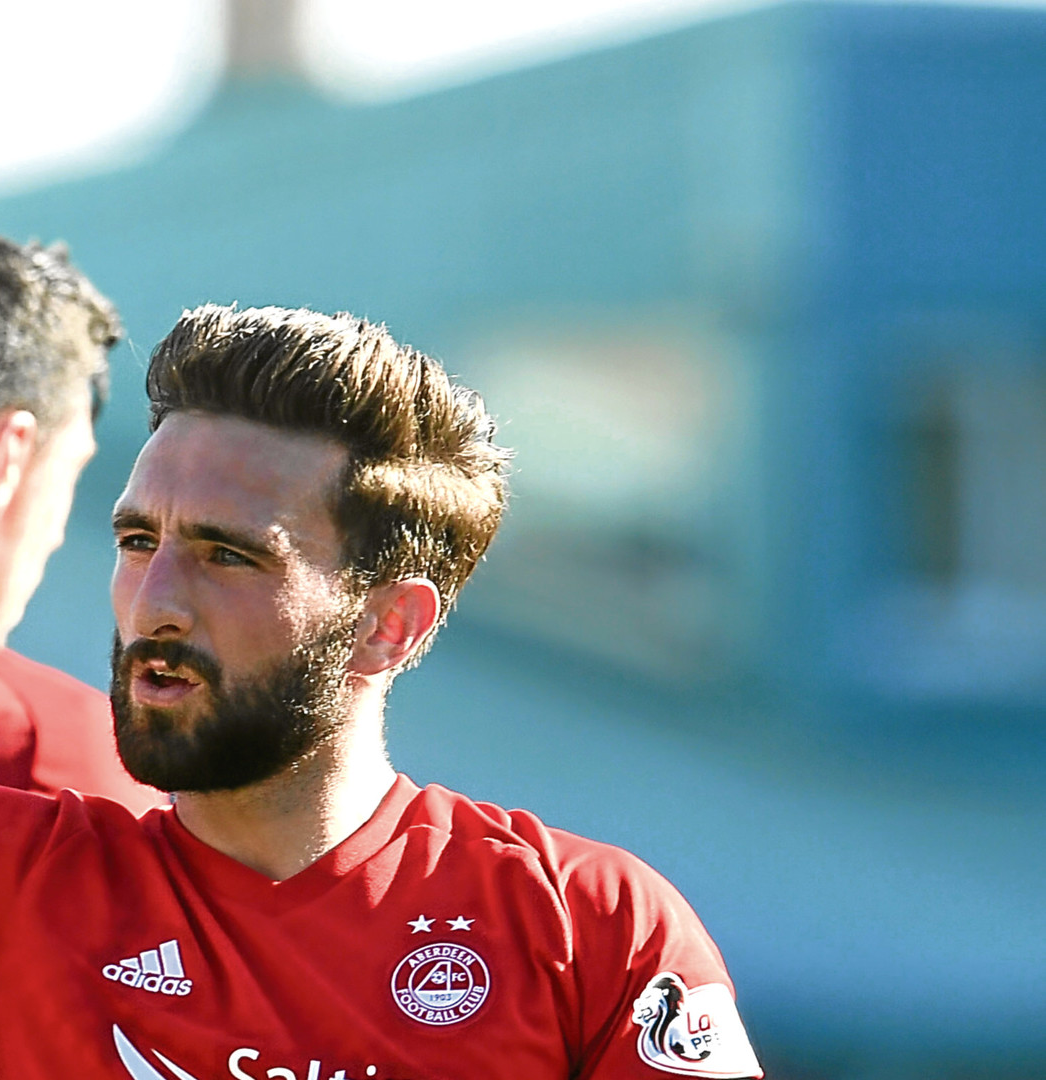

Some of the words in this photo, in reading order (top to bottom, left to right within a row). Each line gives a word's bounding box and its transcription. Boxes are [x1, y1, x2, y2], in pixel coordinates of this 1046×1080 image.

[408, 946, 476, 968] ABERDEEN
[102, 963, 193, 997] adidas
[451, 972, 467, 982] FC
[396, 988, 460, 1022] FOOTBALL
[458, 985, 485, 1014] CLUB
[429, 993, 452, 1002] 1903
